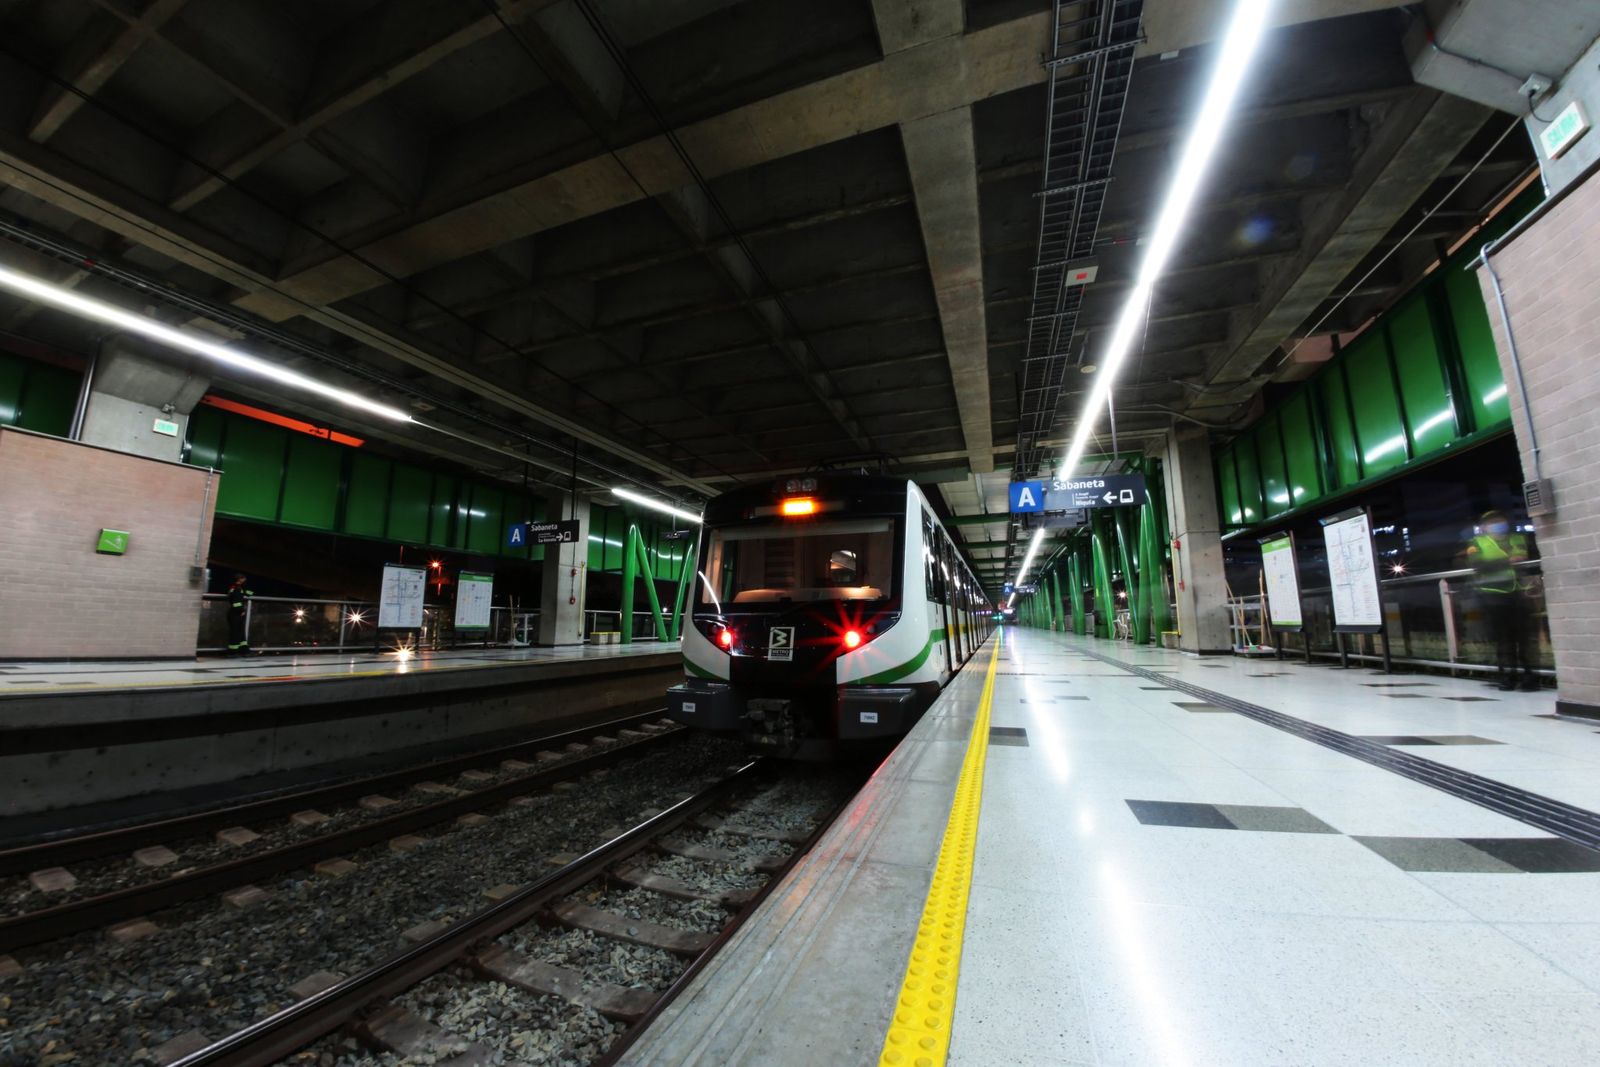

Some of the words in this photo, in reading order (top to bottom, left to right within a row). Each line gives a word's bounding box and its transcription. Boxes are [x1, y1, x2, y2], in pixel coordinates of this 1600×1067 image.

[1053, 479, 1105, 491] Sabaneta
[1018, 487, 1036, 507] A
[511, 528, 521, 543] A
